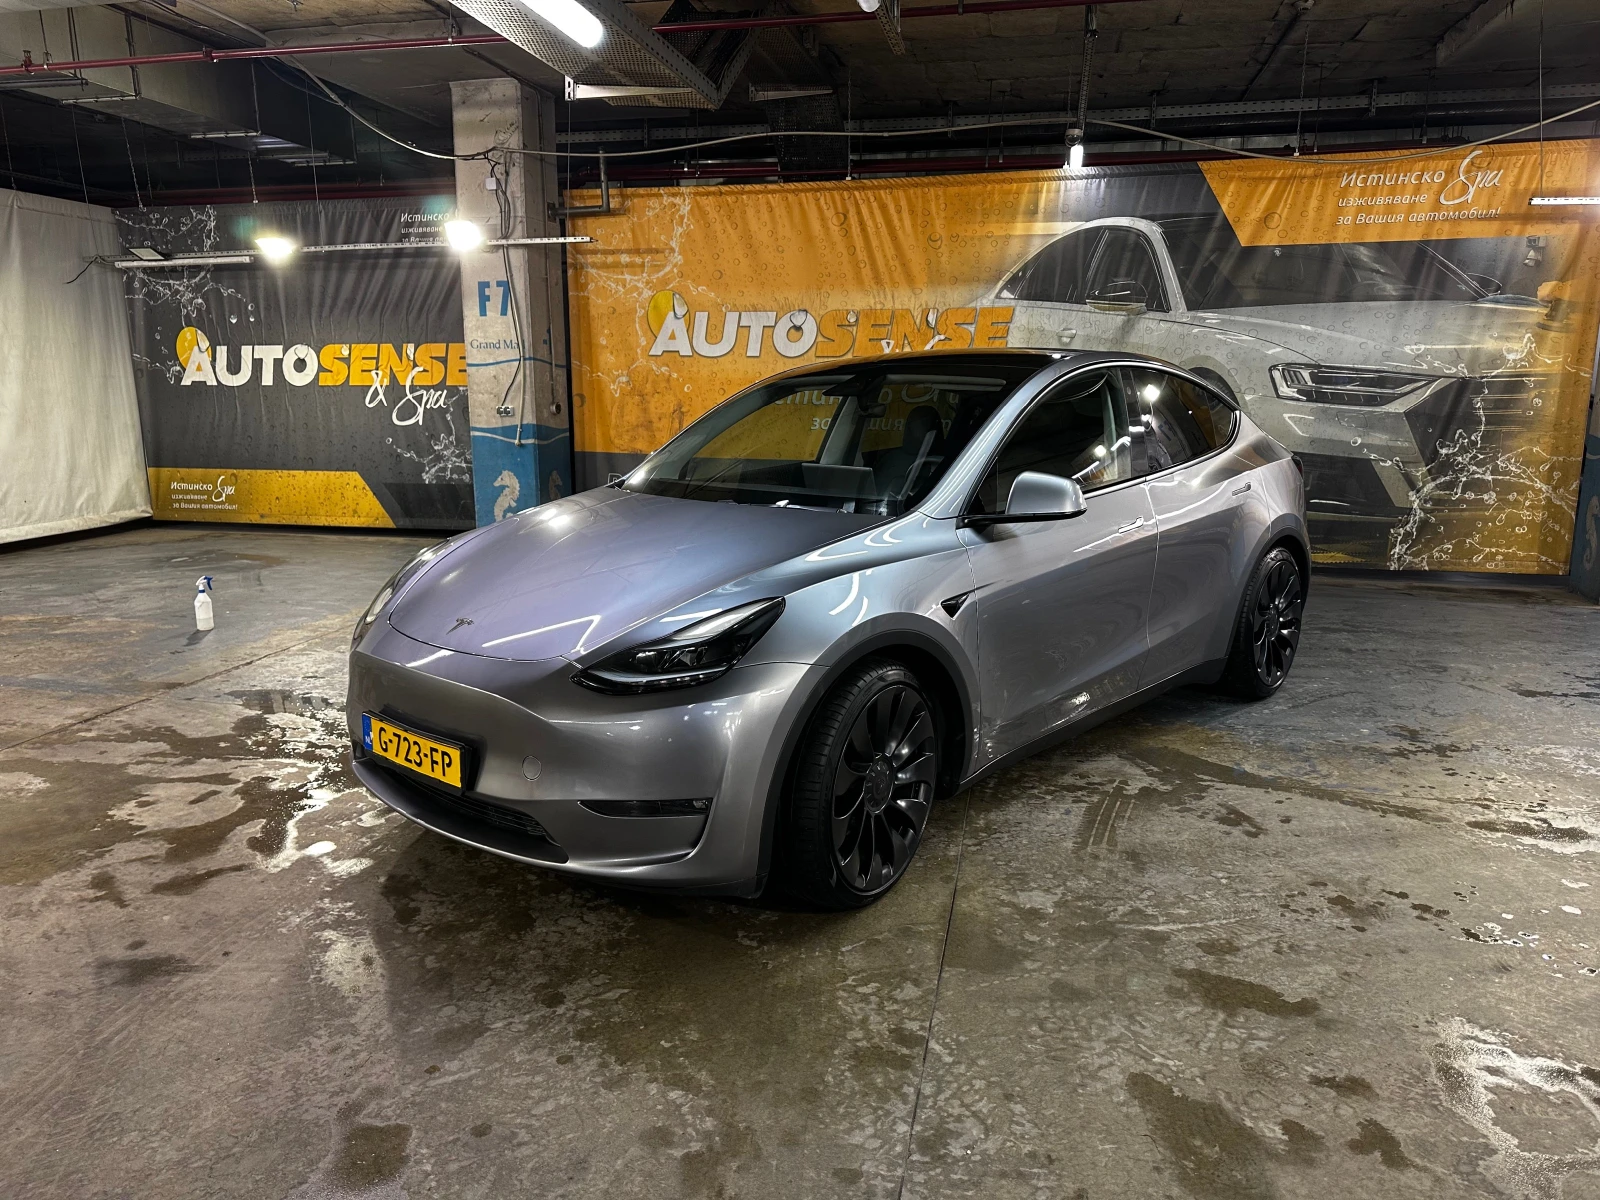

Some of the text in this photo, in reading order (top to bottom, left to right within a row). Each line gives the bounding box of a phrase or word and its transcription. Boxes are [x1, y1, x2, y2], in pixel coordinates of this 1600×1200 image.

[1340, 150, 1504, 205] Истинско Spa
[1338, 194, 1428, 207] изживяване
[400, 212, 450, 222] Истинско
[1336, 206, 1501, 225] за Вашия автомобил!
[470, 338, 501, 350] Grand
[648, 306, 1016, 358] AUTOSENSE
[180, 343, 468, 387] AUTOSENSE
[365, 366, 448, 426] & Spa
[171, 475, 236, 502] Истинско Spa
[201, 503, 238, 511] автомобил!
[378, 726, 453, 777] G-723-FP
